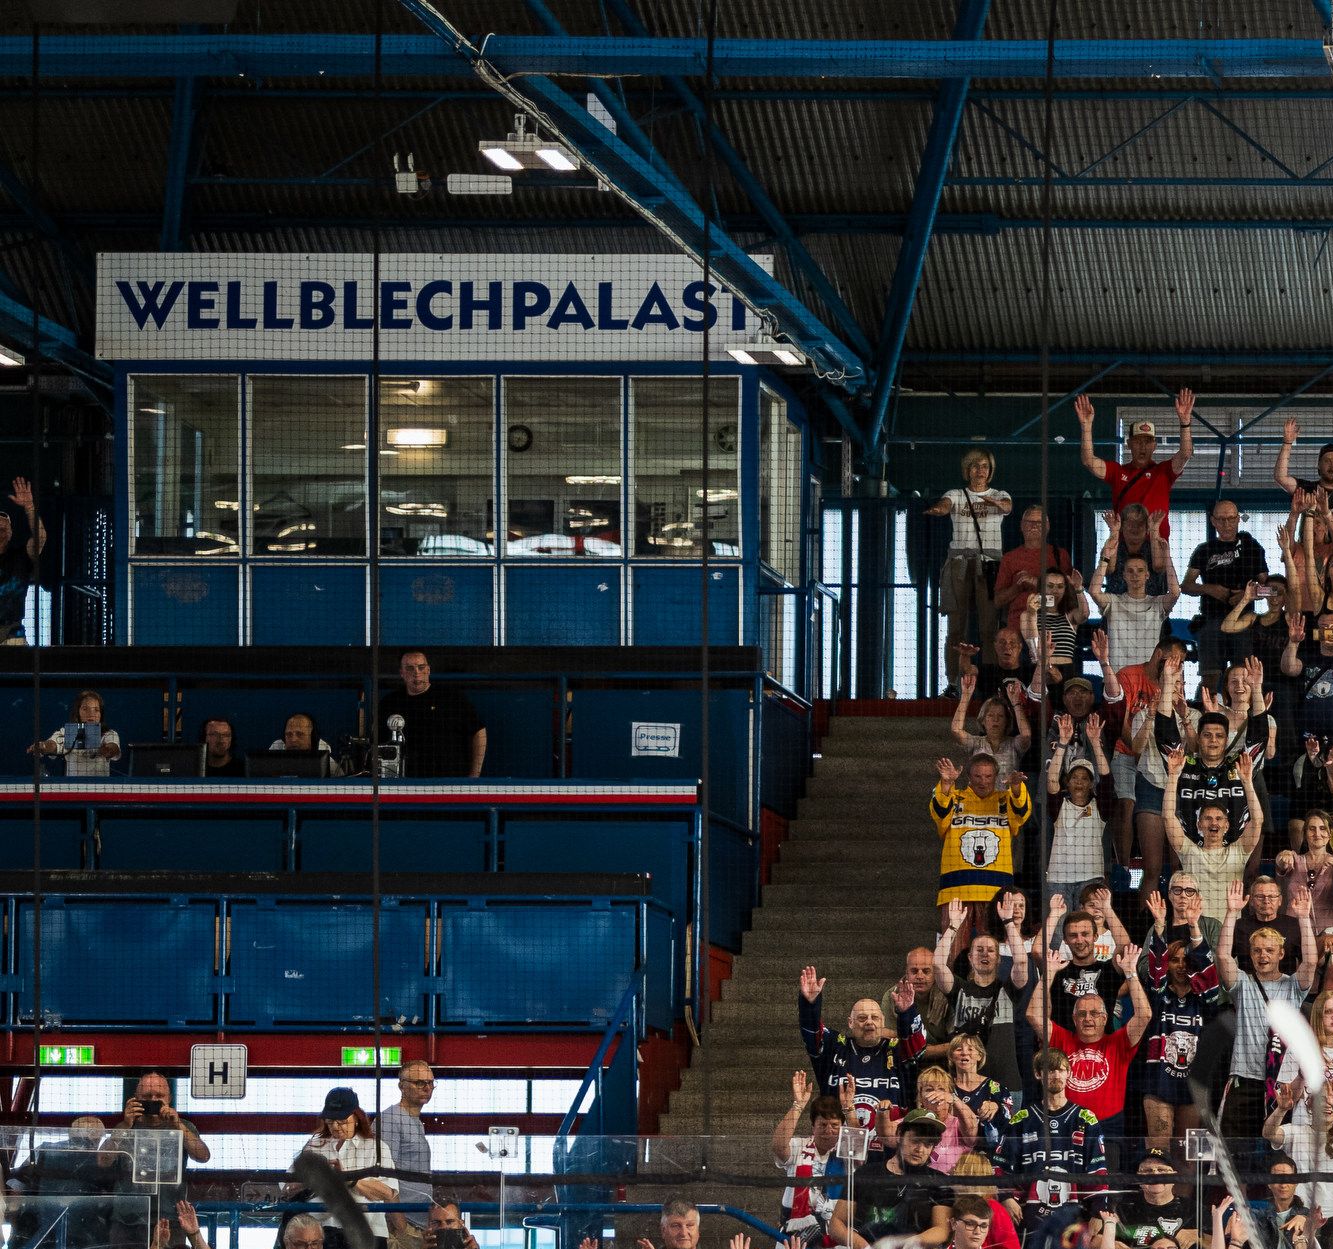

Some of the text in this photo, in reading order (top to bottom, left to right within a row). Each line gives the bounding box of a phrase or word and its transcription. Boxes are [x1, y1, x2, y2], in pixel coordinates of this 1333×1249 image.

[115, 279, 746, 332] WELLBLECHPALAST
[1181, 786, 1244, 800] GASAG
[951, 816, 1009, 827] GASAG
[208, 1061, 228, 1085] H
